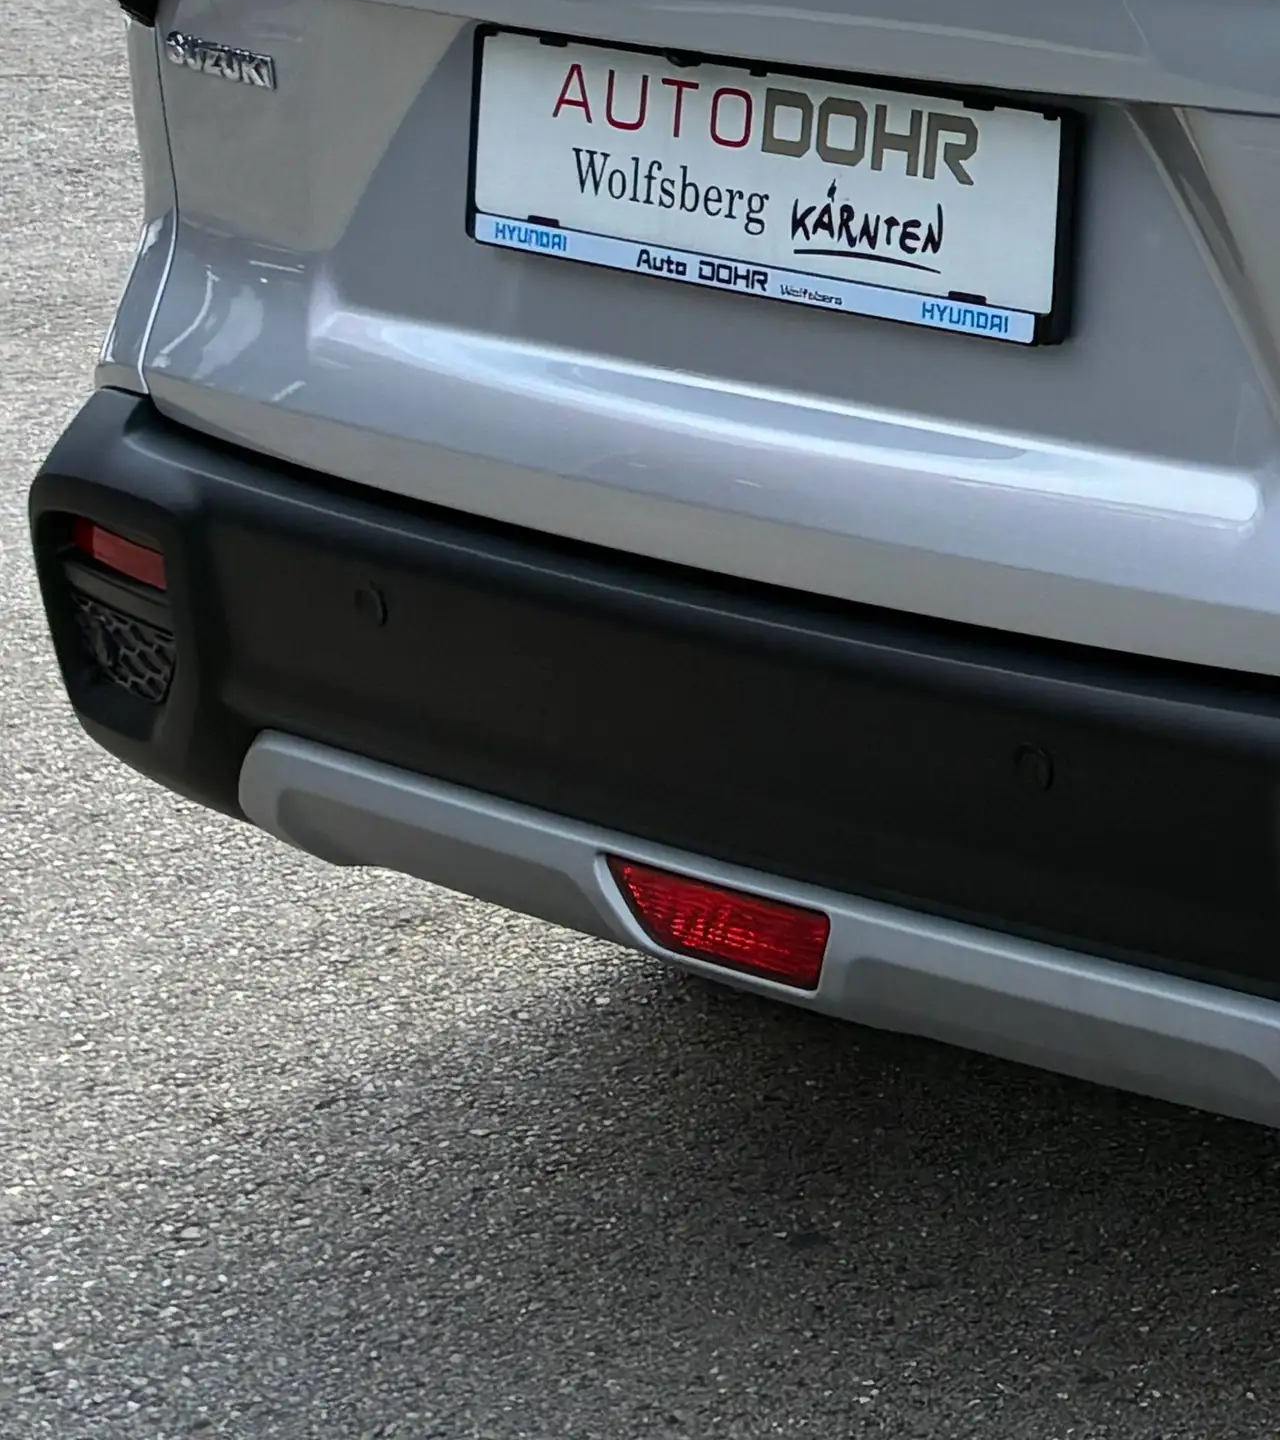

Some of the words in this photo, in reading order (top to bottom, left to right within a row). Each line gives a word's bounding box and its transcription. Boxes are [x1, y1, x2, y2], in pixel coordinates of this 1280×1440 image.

[166, 31, 278, 91] SUZUKI
[572, 147, 770, 236] Wolfsberg
[494, 221, 568, 252] HYUNDAI
[636, 248, 687, 276] Auto
[698, 259, 769, 292] DOHR
[922, 301, 1009, 334] HYUNDAI
